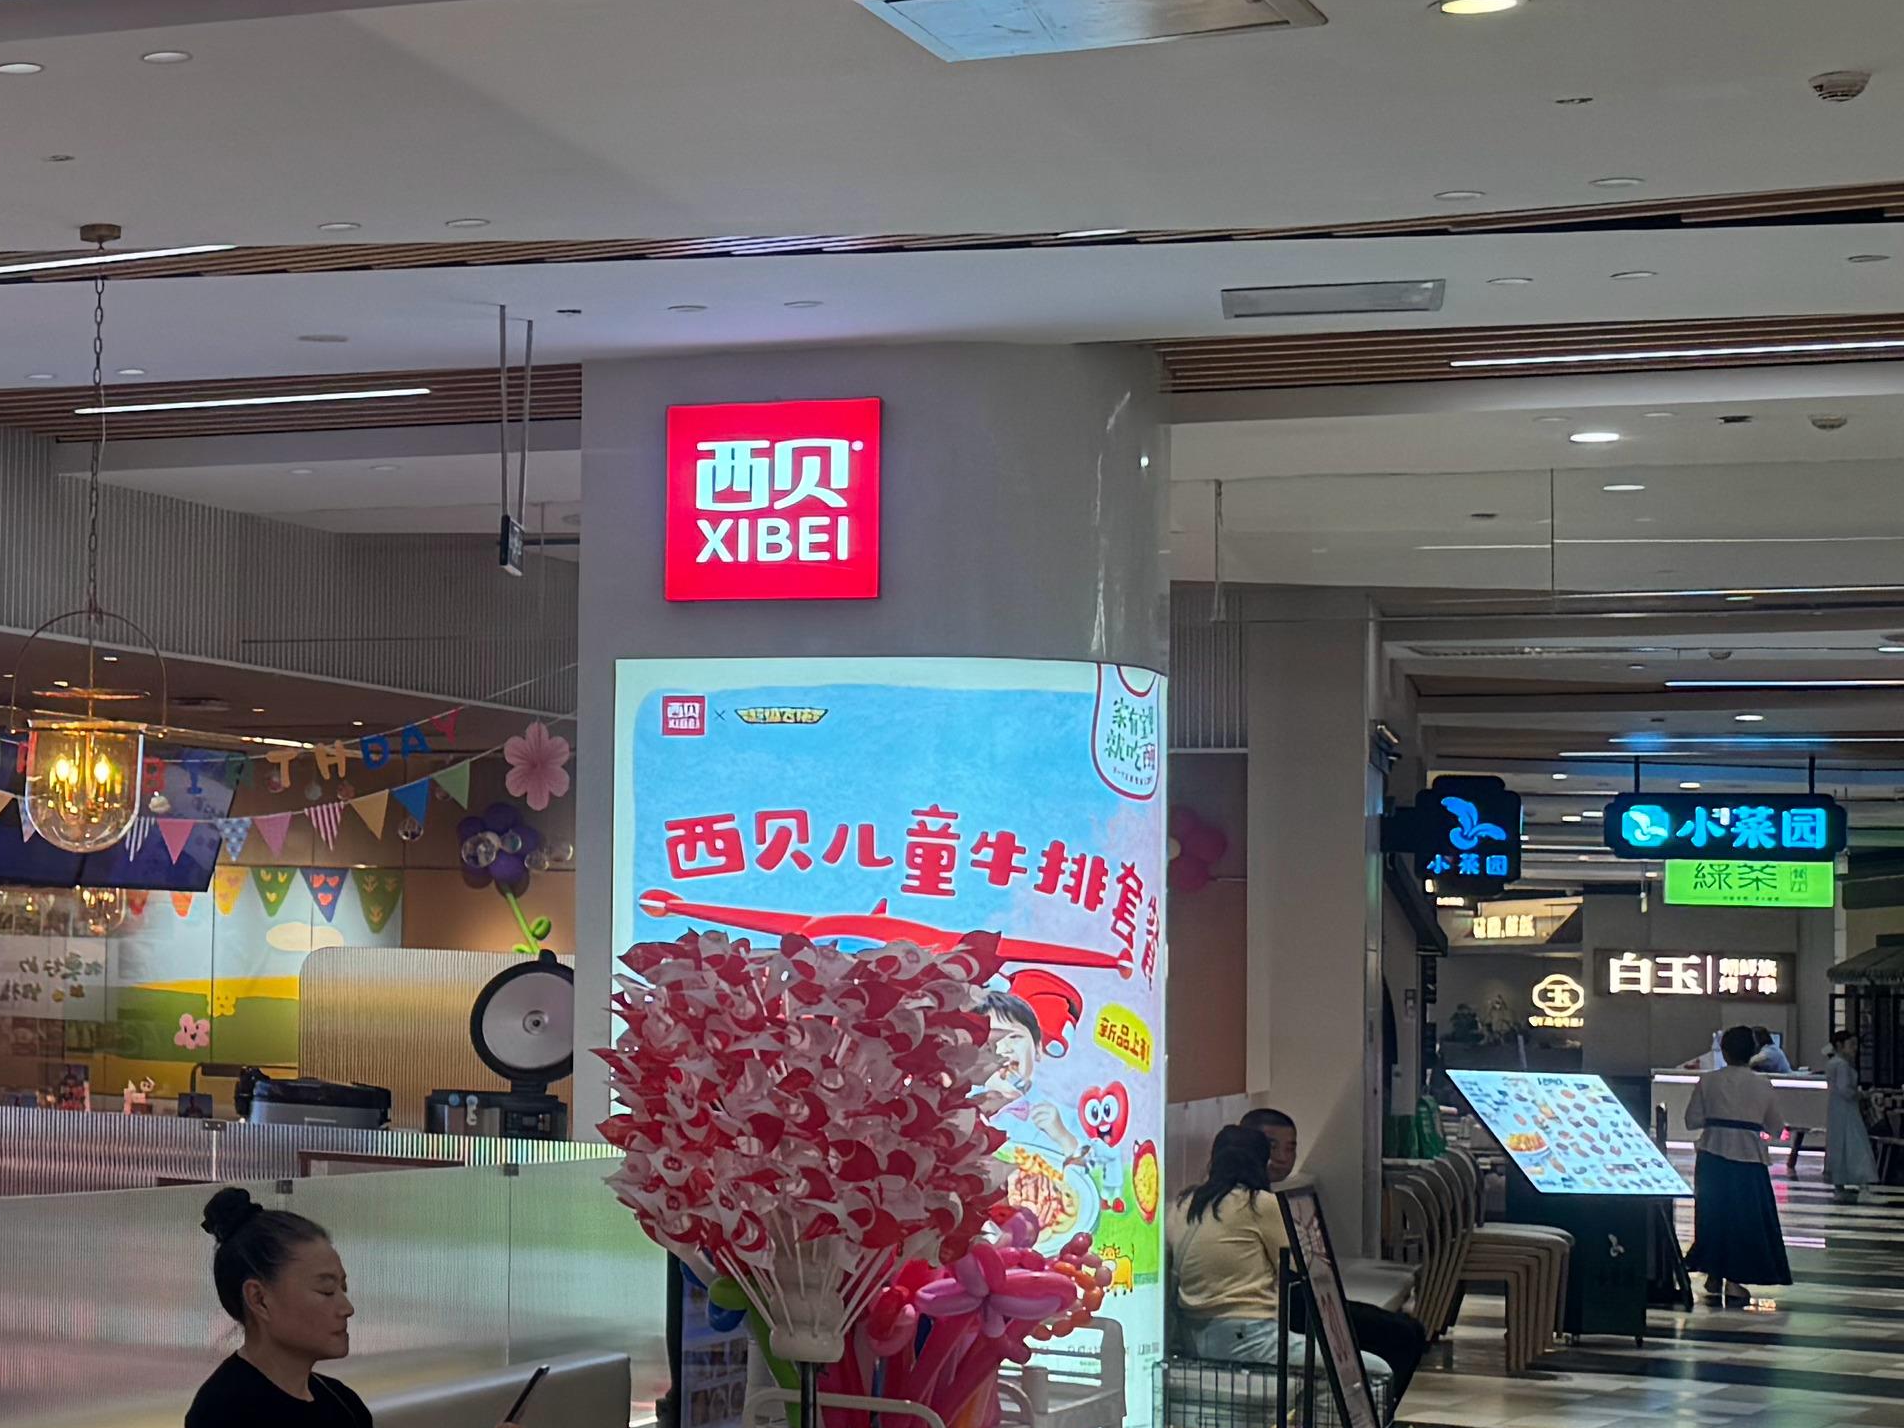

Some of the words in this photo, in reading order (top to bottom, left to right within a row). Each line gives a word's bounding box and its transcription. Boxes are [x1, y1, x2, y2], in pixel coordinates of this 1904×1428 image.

[695, 438, 849, 511] 西贝
[695, 515, 849, 563] XIBEI
[1676, 806, 1827, 849] 小菜园
[1426, 853, 1509, 876] 小菜园
[1609, 952, 1704, 994] 白玉
